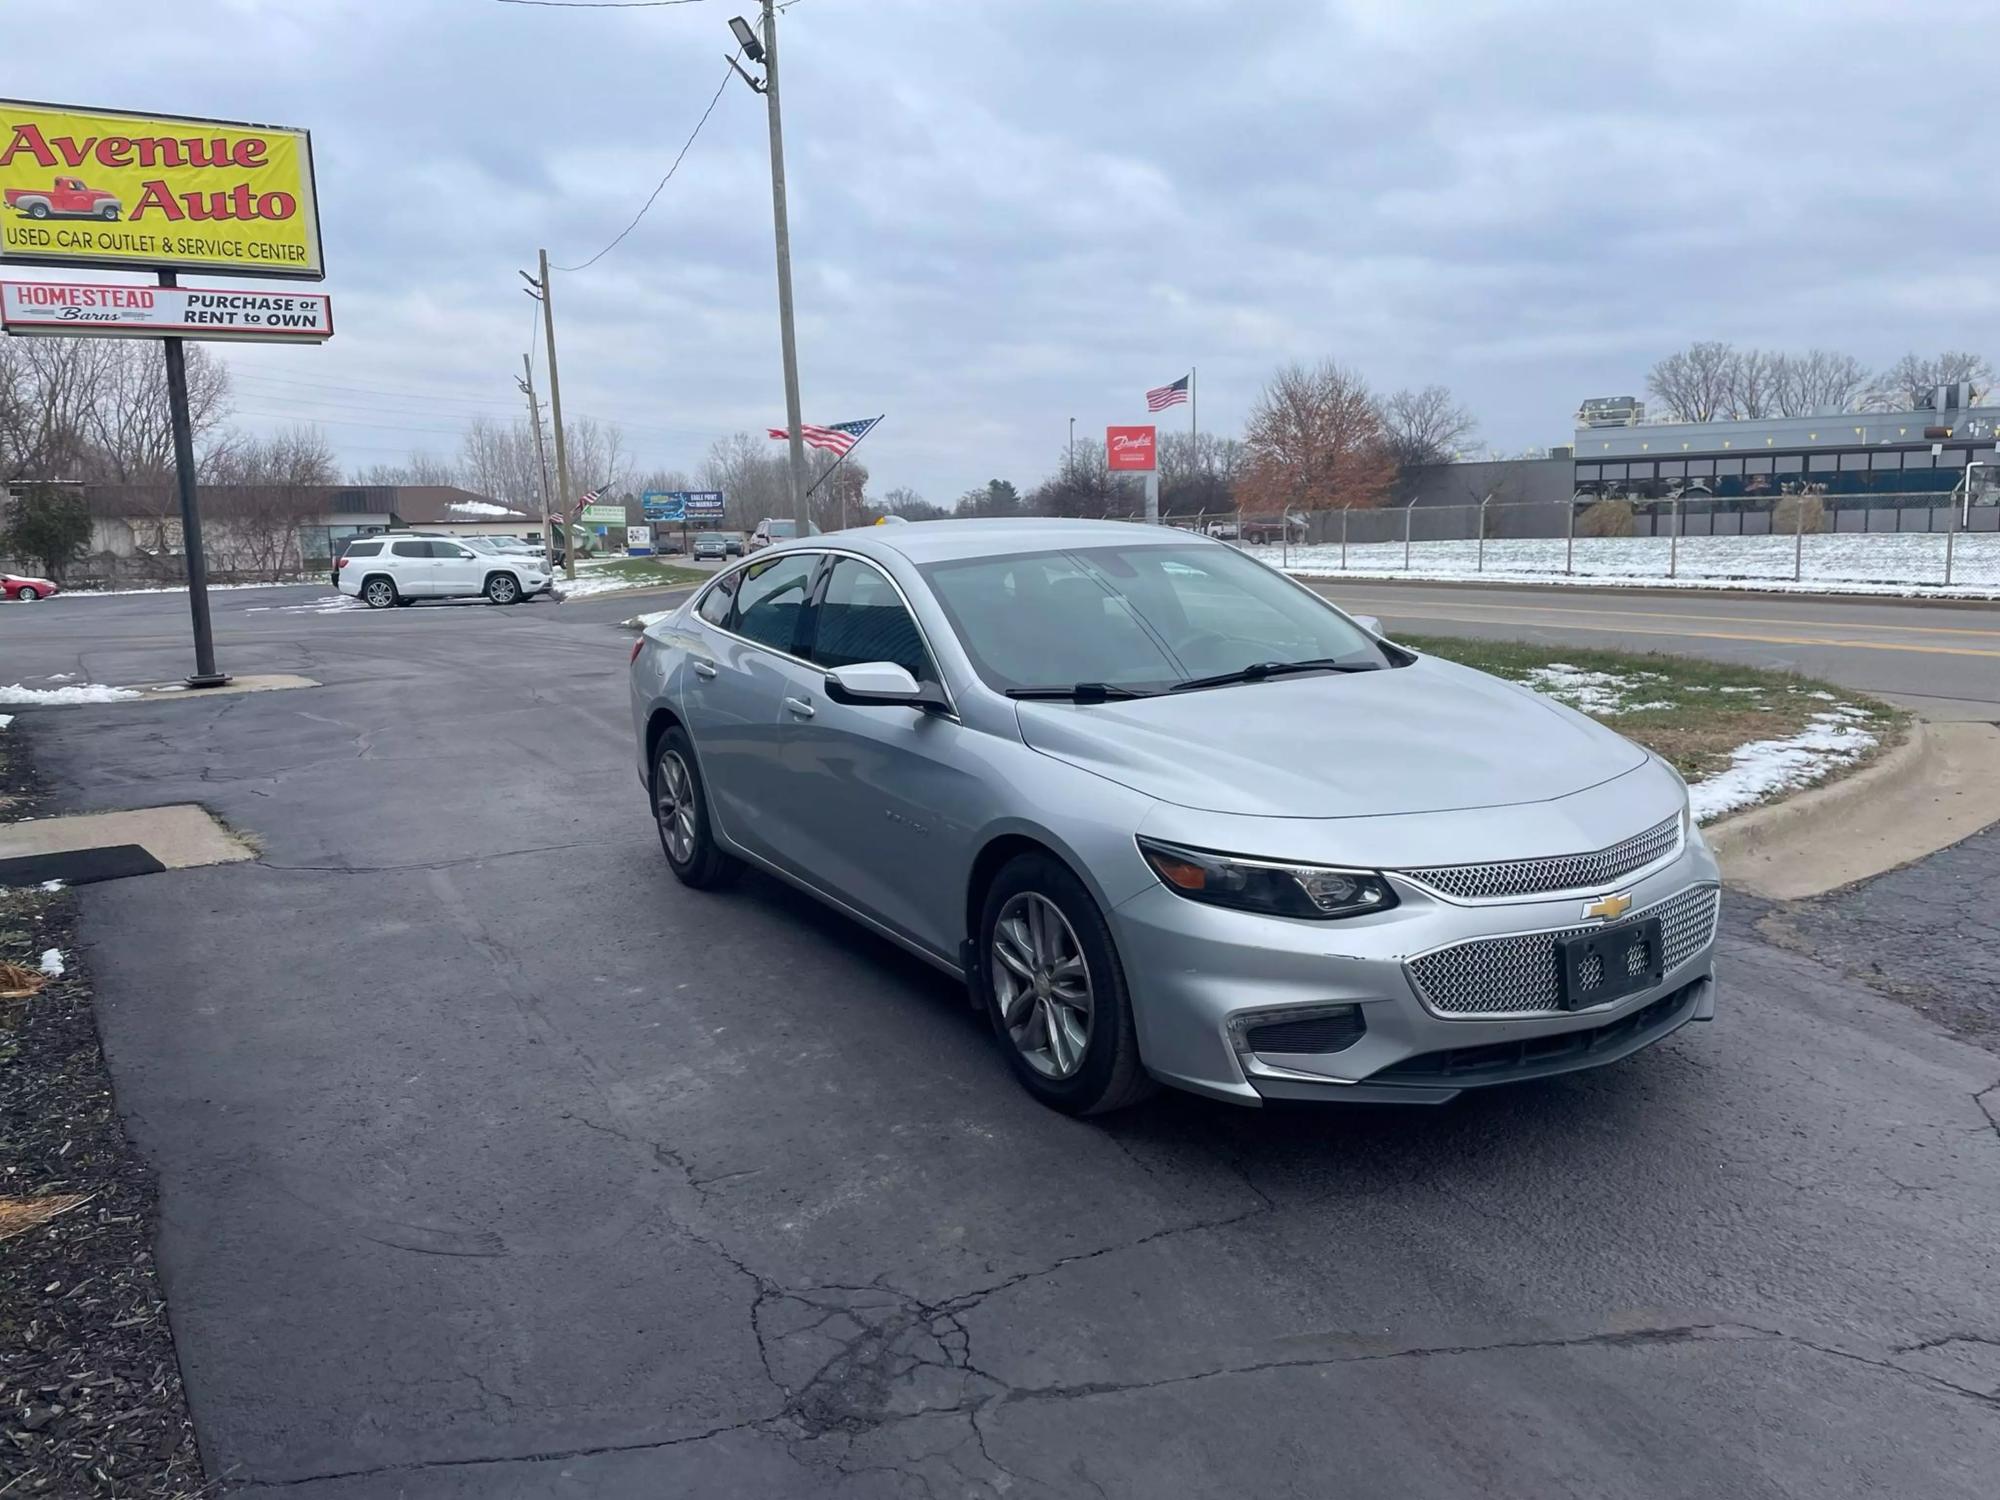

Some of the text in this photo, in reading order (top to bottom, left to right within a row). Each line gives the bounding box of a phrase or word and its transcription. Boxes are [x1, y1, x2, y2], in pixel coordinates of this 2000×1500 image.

[0, 123, 269, 168] Avenue
[128, 180, 297, 222] Auto
[6, 227, 306, 262] USED CAR OUTLET & SERVICE CENTER
[17, 286, 155, 309] HOMESTEAD
[187, 295, 318, 311] PURCHASE or
[55, 306, 121, 321] Barns
[183, 310, 317, 328] RENT to OWN
